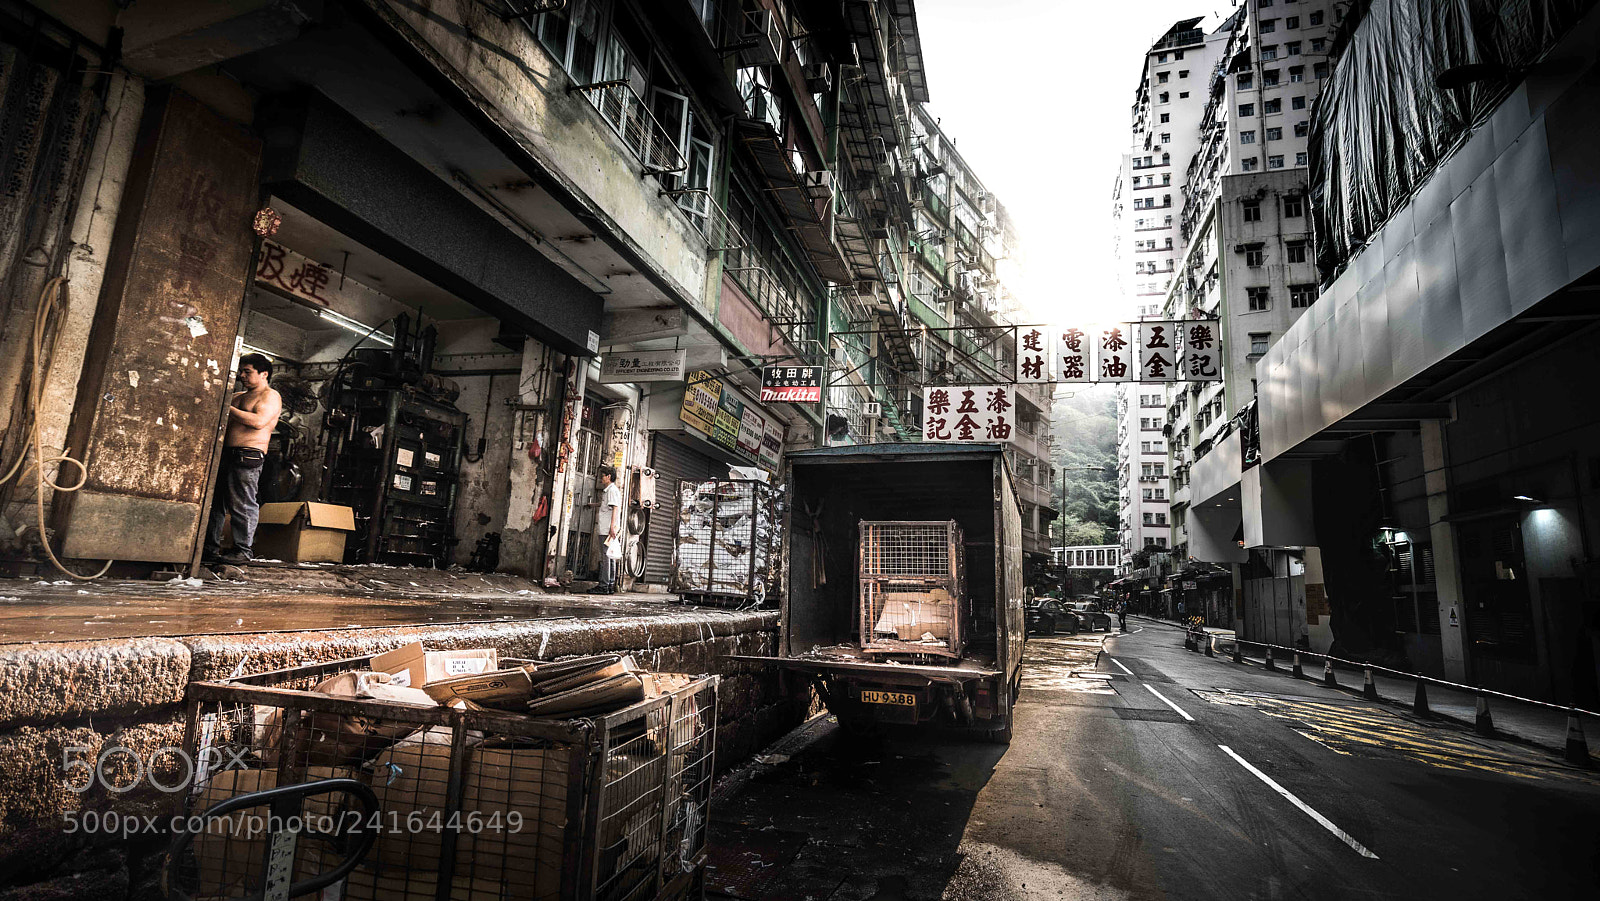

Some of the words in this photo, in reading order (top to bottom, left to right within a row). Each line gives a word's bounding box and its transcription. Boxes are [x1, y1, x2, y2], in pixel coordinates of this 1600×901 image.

[771, 368, 813, 379] 牧田牌
[1020, 328, 1045, 379] 建材
[1062, 327, 1084, 379] 電器
[1102, 327, 1128, 379] 漆油
[1144, 325, 1173, 378] 五金
[1188, 324, 1217, 377] 樂記
[766, 379, 817, 387] 专业电动工具
[926, 389, 952, 441] 樂記
[953, 389, 981, 441] 五金
[985, 388, 1012, 441] 漆油
[863, 692, 879, 702] HU
[882, 693, 913, 704] 9388
